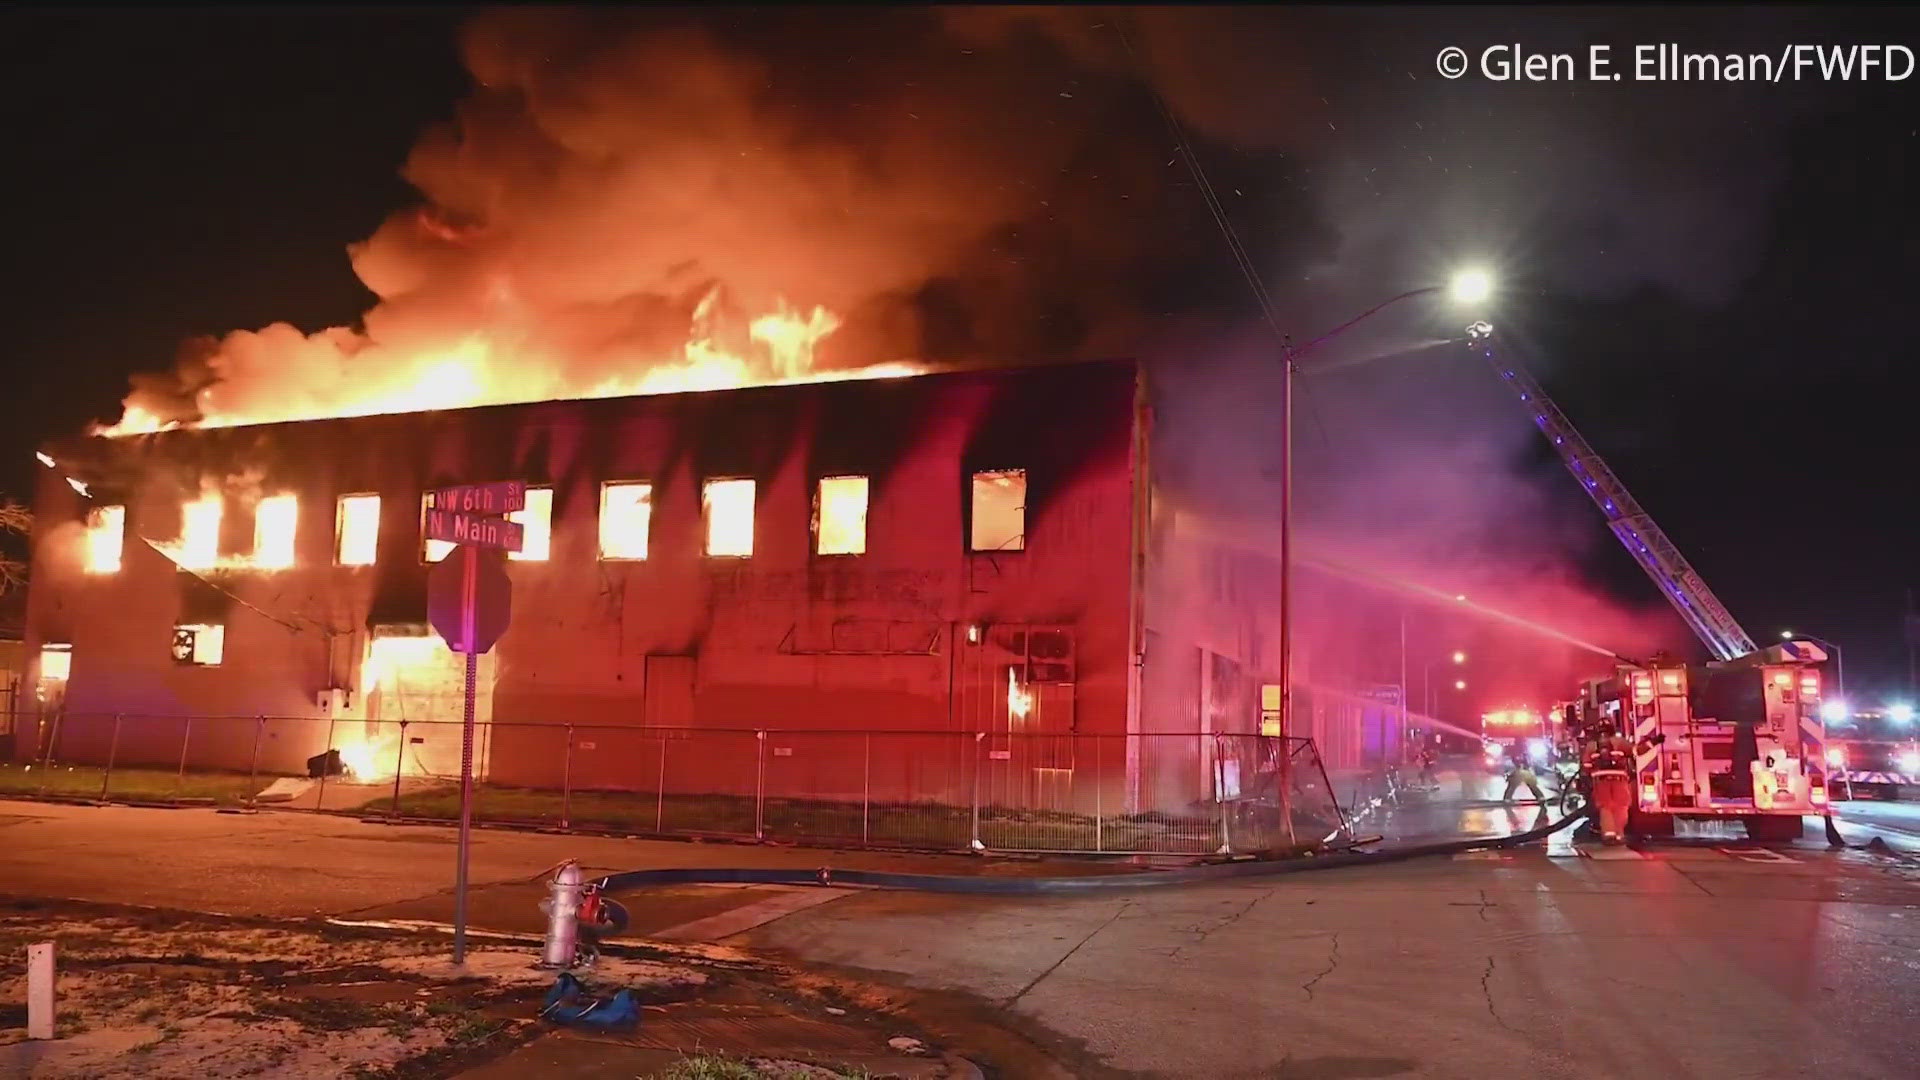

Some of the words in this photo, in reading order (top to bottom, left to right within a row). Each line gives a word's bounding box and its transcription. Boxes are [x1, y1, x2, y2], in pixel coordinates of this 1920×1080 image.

[436, 491, 457, 511] NW
[463, 488, 493, 511] 6th
[504, 496, 523, 510] 100
[430, 511, 443, 535] N
[454, 513, 497, 544] Main
